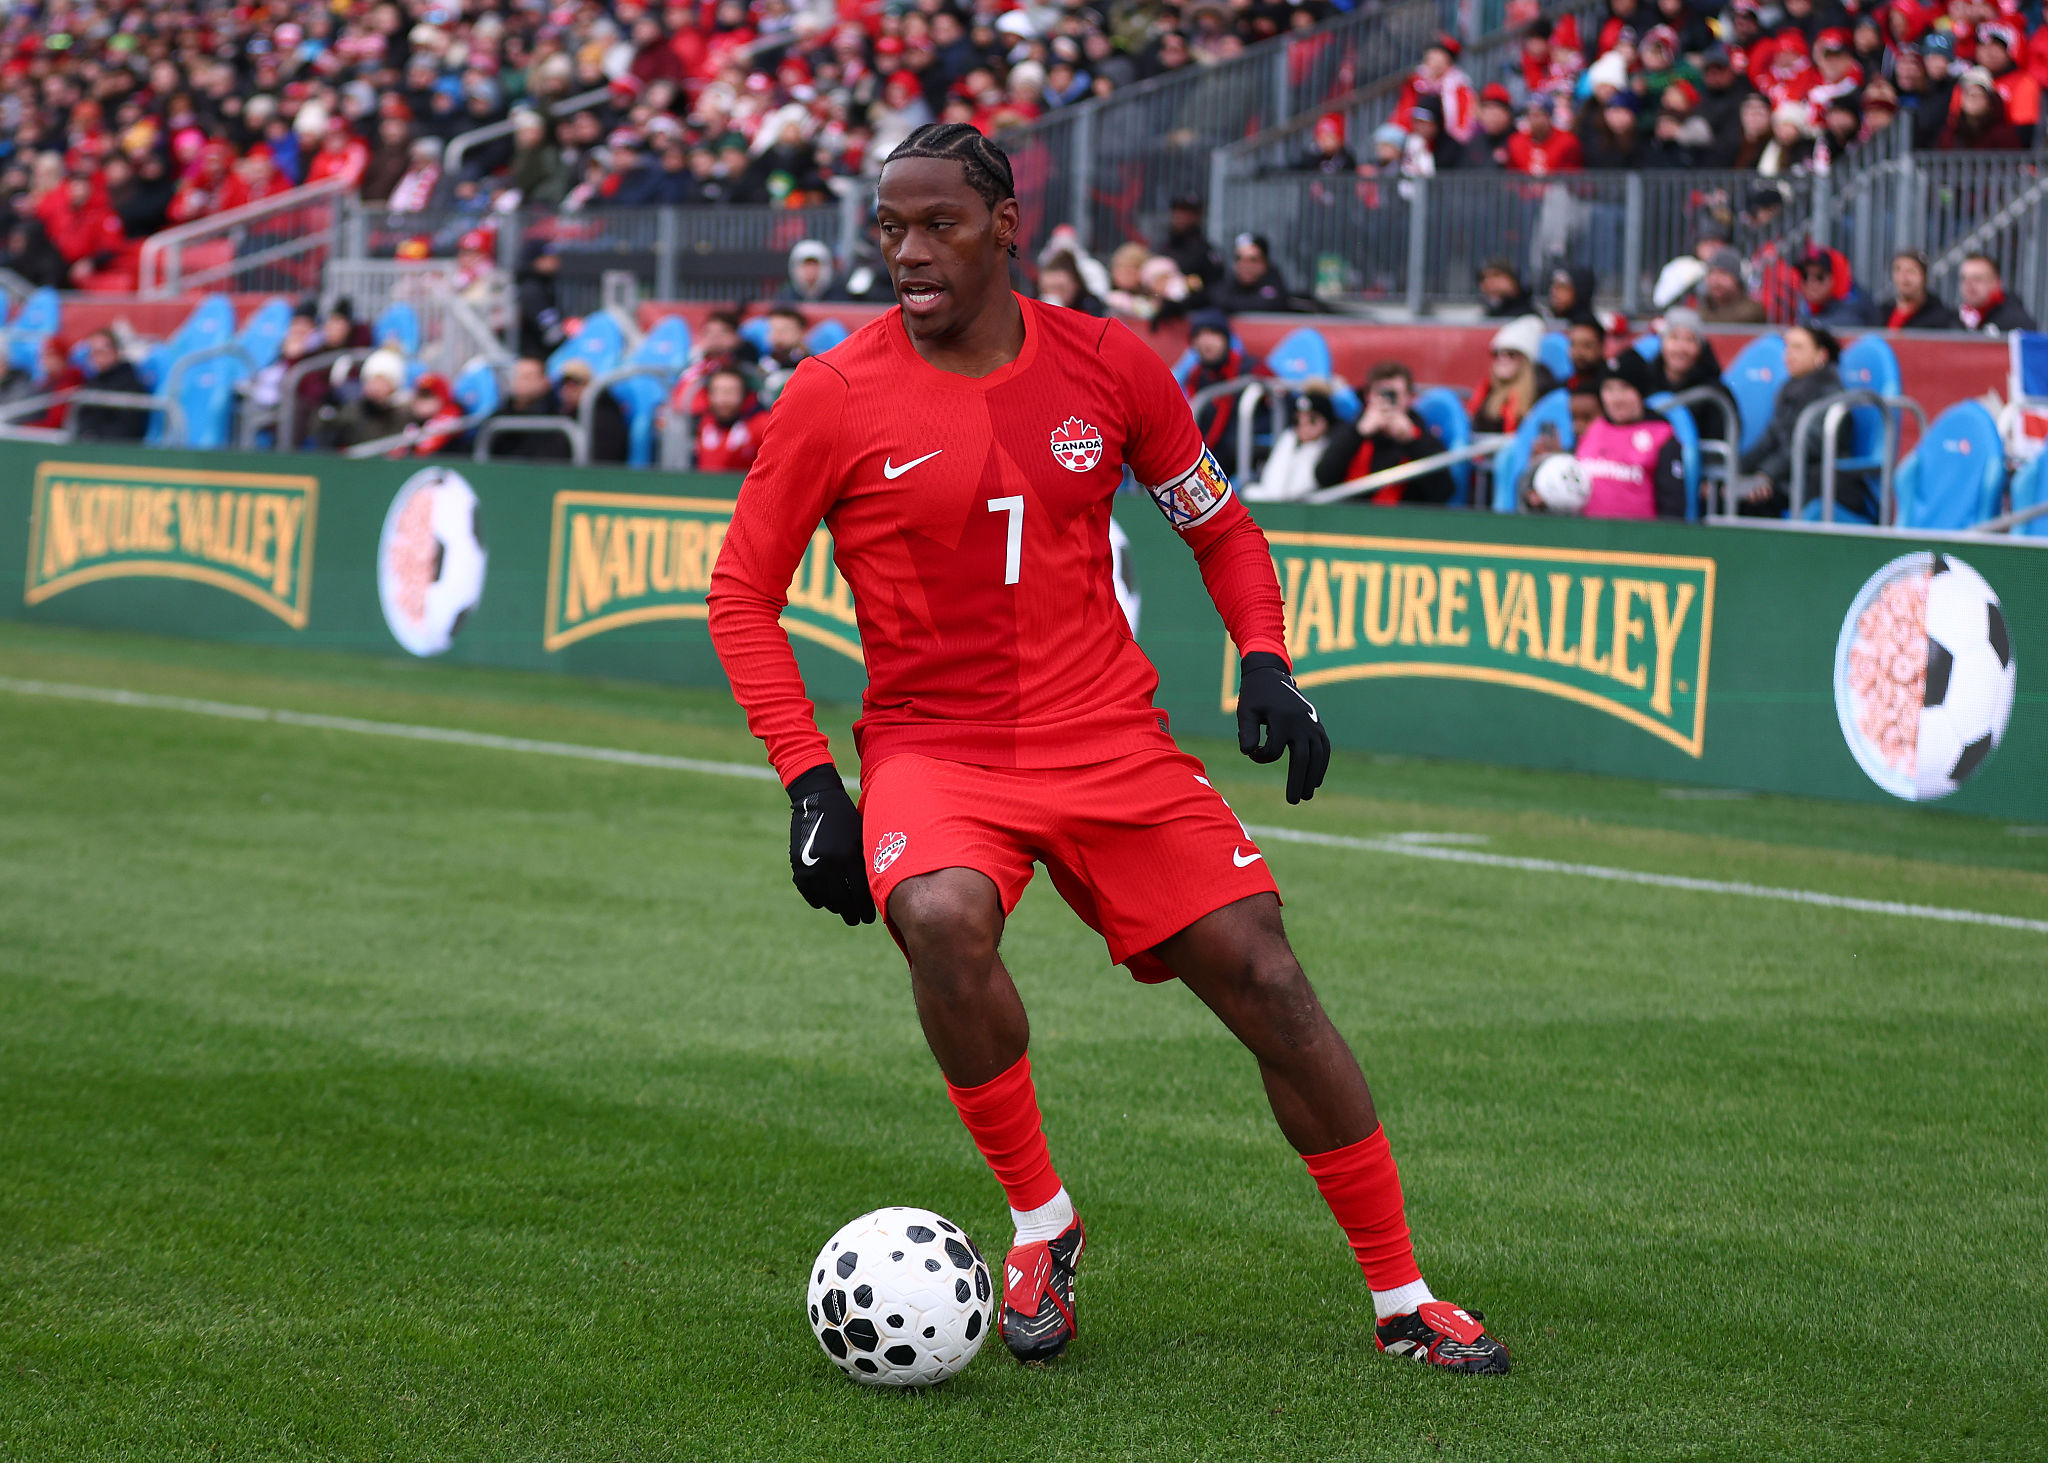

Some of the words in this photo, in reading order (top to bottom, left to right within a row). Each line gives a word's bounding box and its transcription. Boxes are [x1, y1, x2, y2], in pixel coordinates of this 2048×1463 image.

[1053, 440, 1101, 452] CANADA
[42, 481, 176, 579] NATURE
[177, 487, 304, 597] VALLEY
[987, 494, 1024, 585] 7
